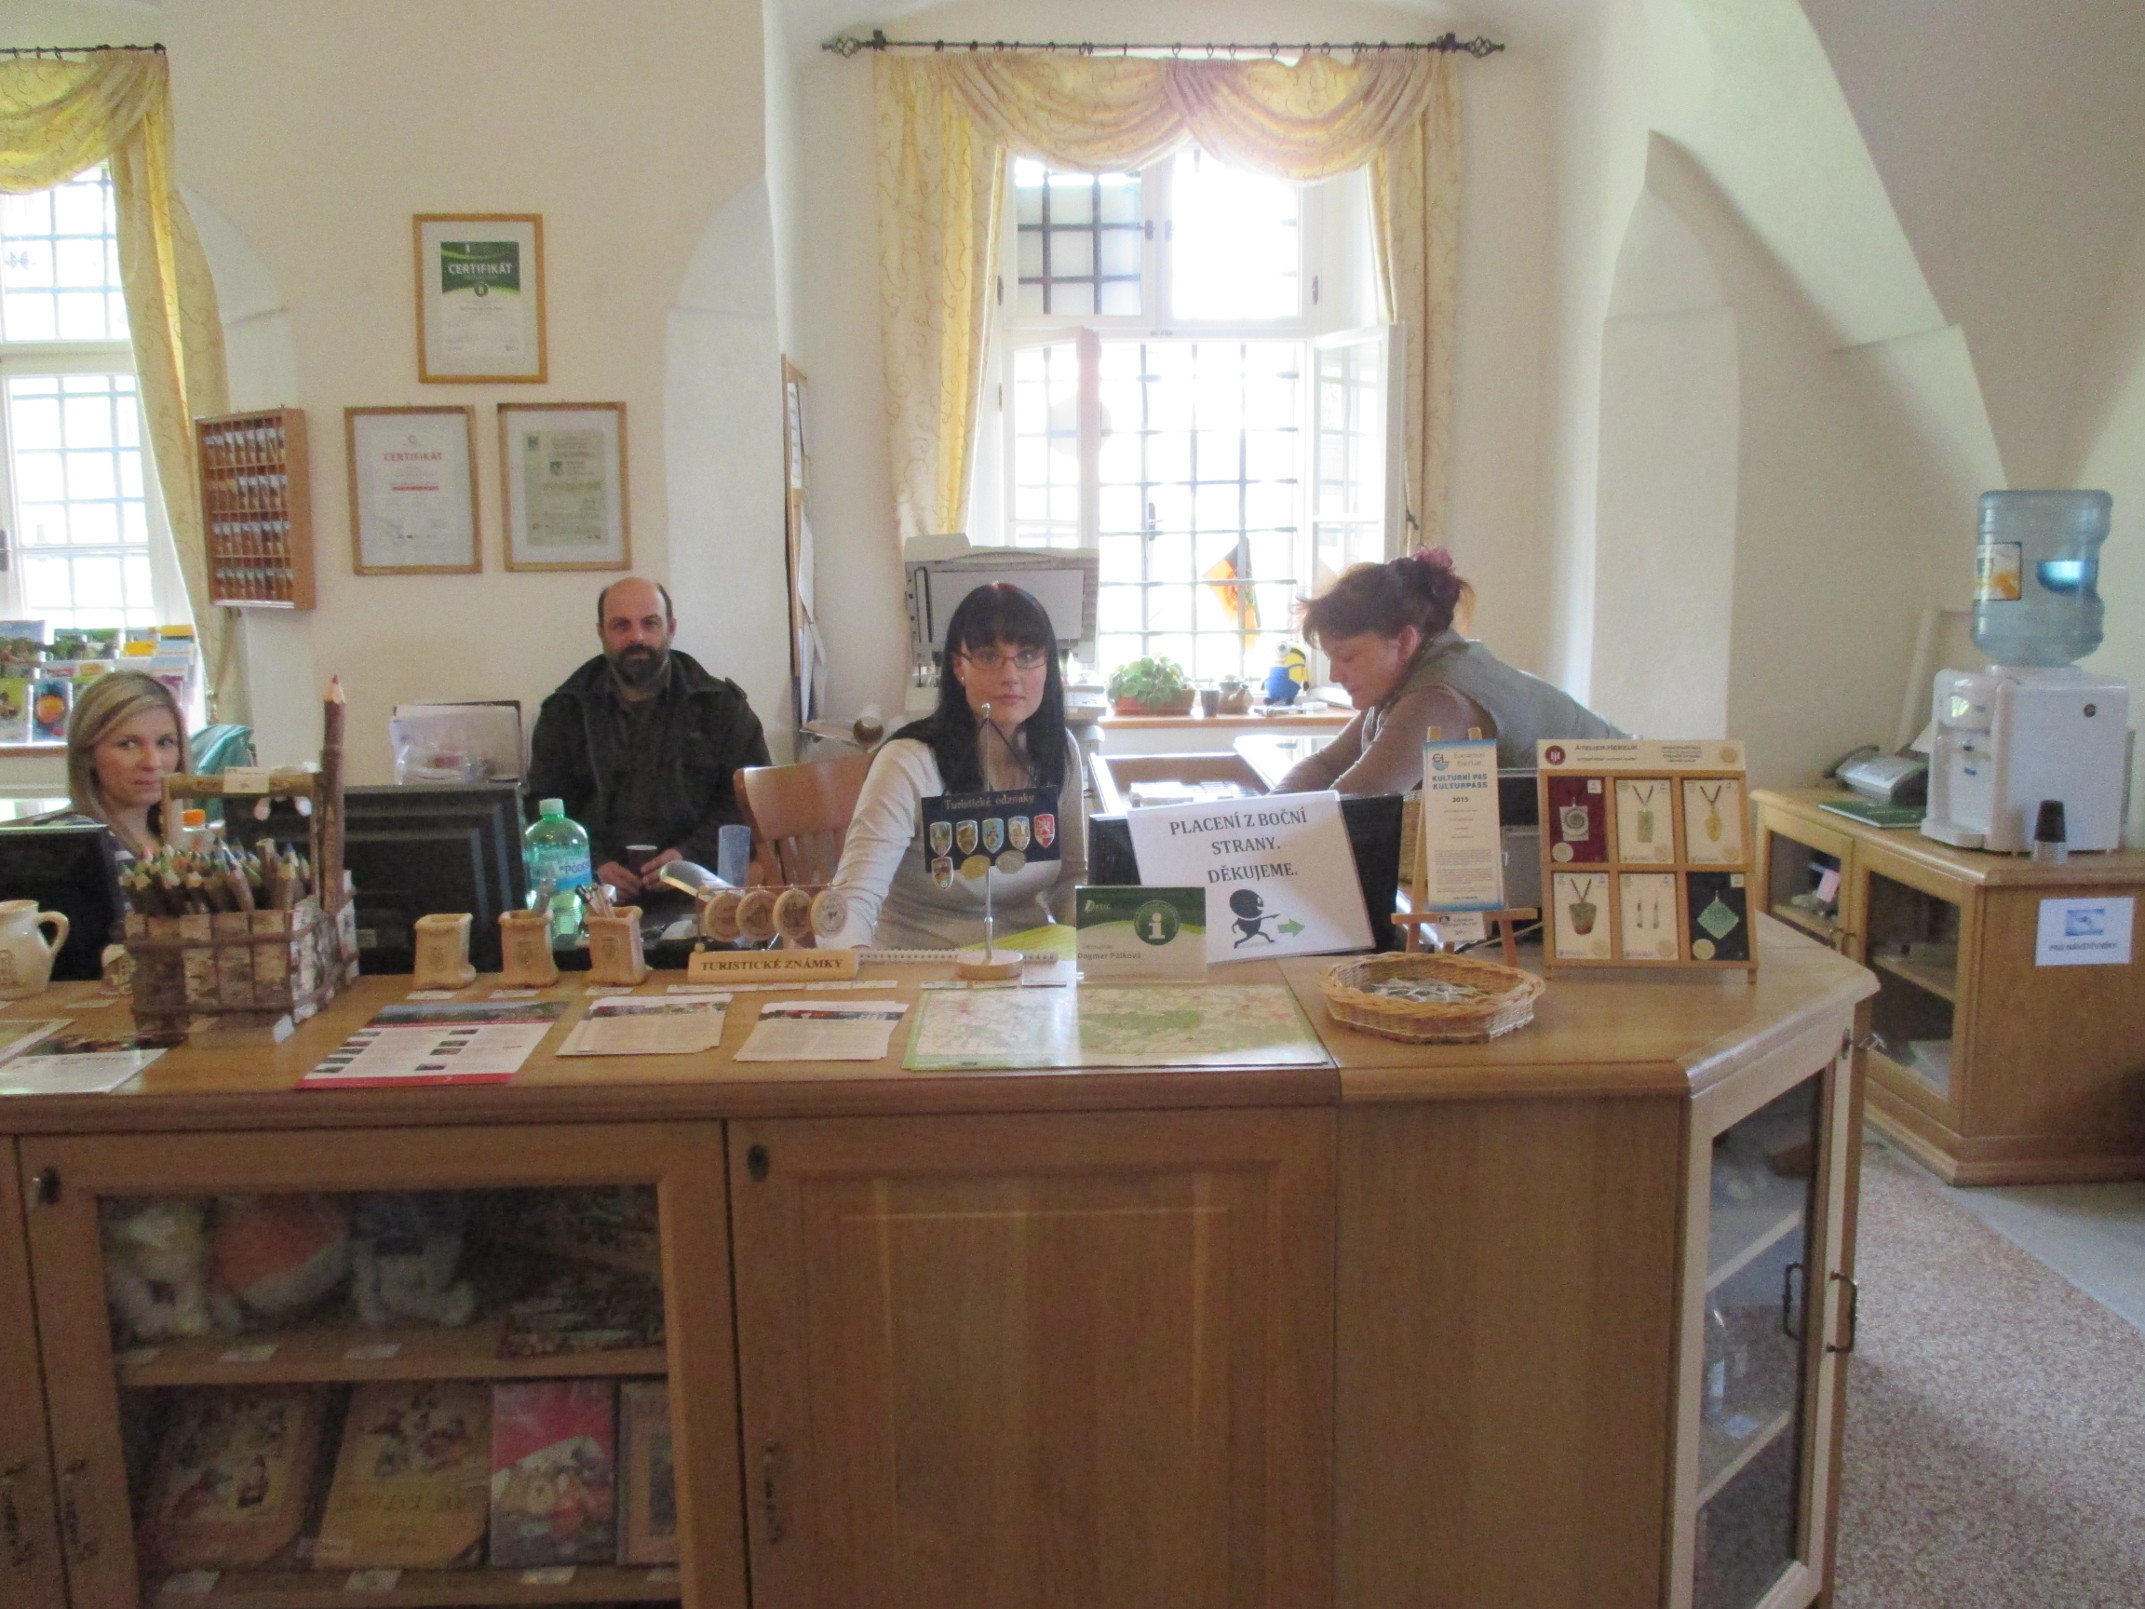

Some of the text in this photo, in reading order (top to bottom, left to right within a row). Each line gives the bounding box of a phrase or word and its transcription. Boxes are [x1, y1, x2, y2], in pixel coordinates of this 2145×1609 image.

[1432, 781, 1489, 790] KULTURPASS
[944, 797, 992, 811] Turistické
[1170, 806, 1308, 836] PLACENÍ Z BOČNÍ
[1211, 836, 1281, 856] STRANY.
[1207, 862, 1298, 885] DĚKUJEME.
[701, 957, 843, 970] TURISTICKÉ ZNÁMKY
